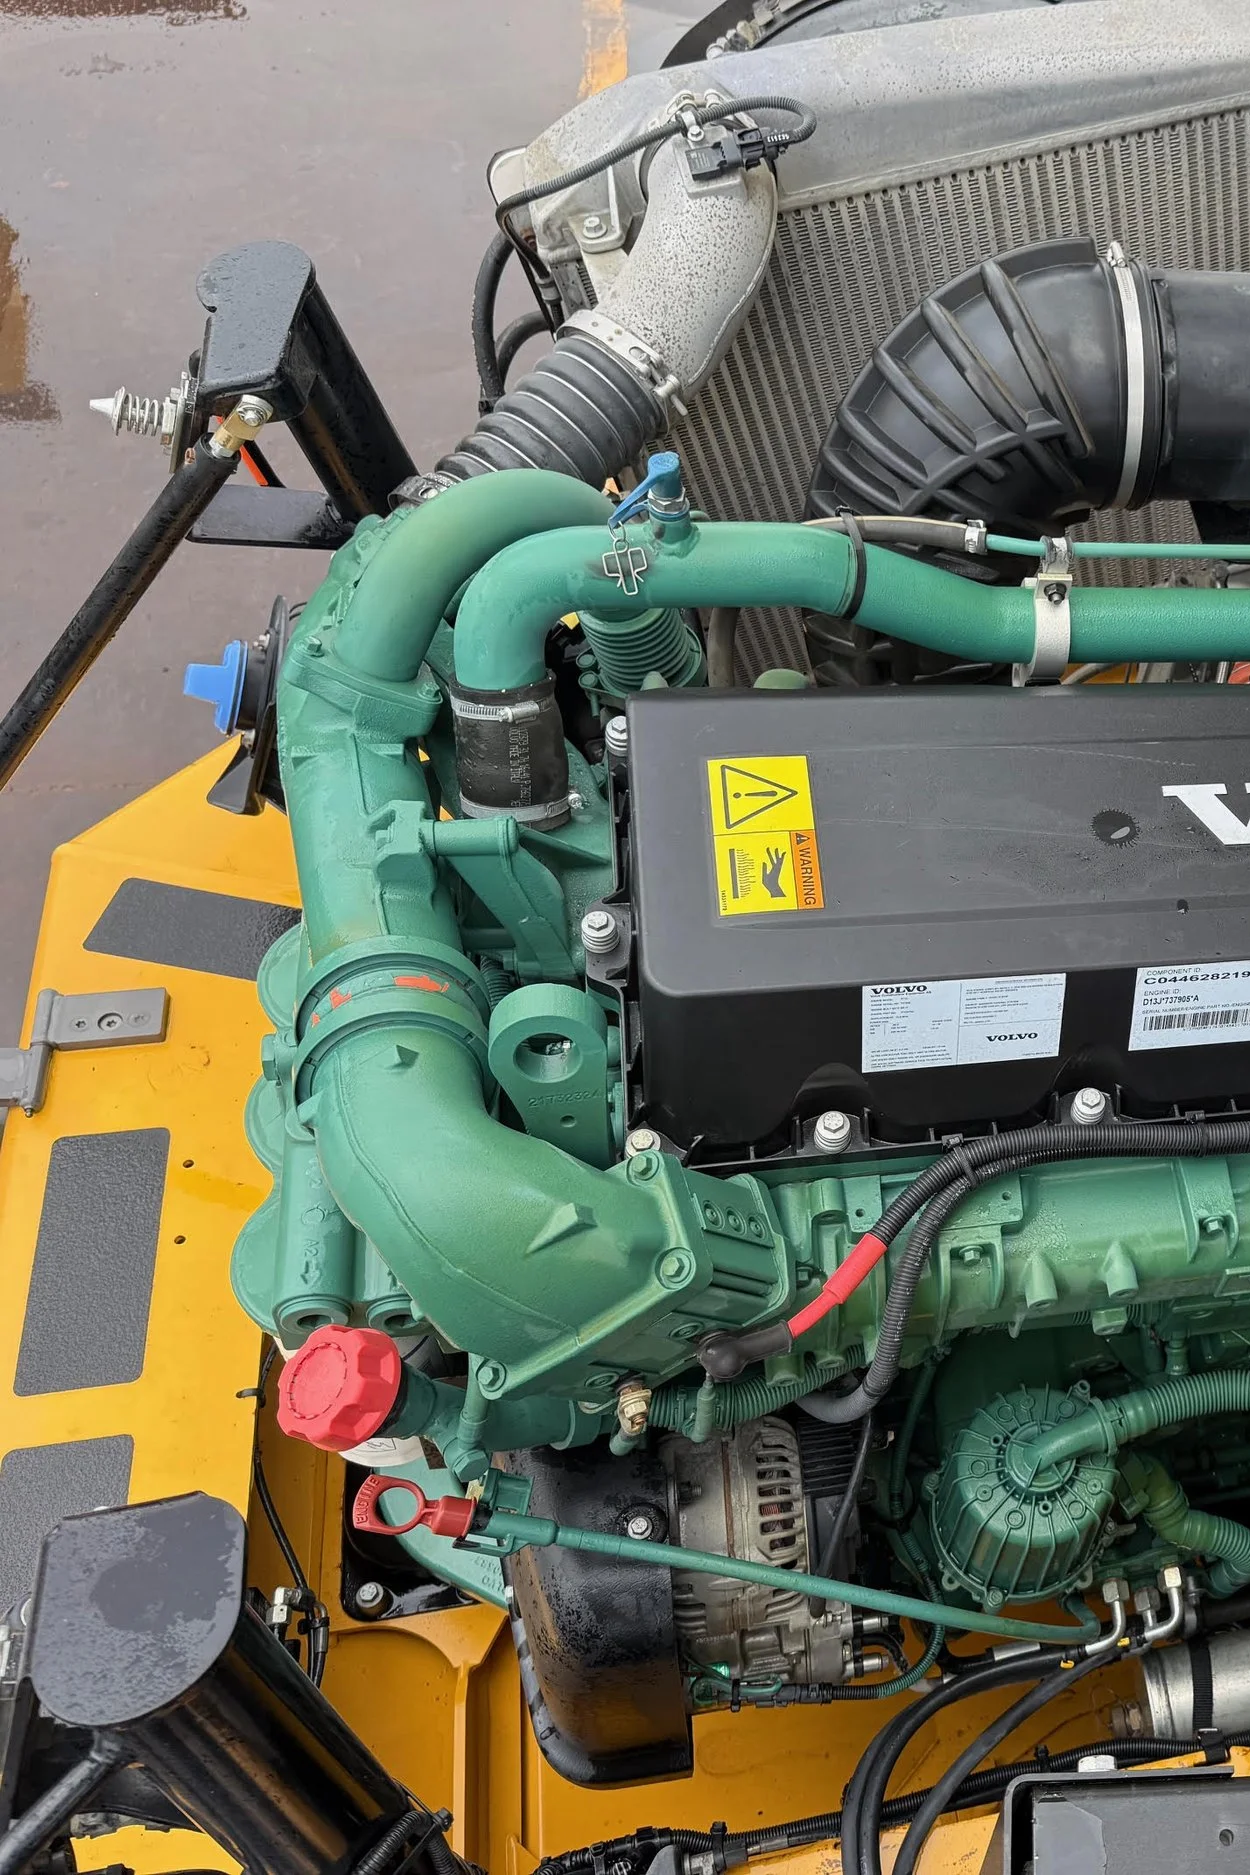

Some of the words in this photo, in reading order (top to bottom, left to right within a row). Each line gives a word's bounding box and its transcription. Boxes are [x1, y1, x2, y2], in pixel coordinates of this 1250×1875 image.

[798, 847, 817, 906] WARNING
[1146, 967, 1192, 976] COMPONENT
[871, 984, 928, 995] VOLVO
[1143, 989, 1171, 997] ENGINE
[986, 1032, 1038, 1042] VOLVO
[355, 1476, 380, 1525] ENGINE
